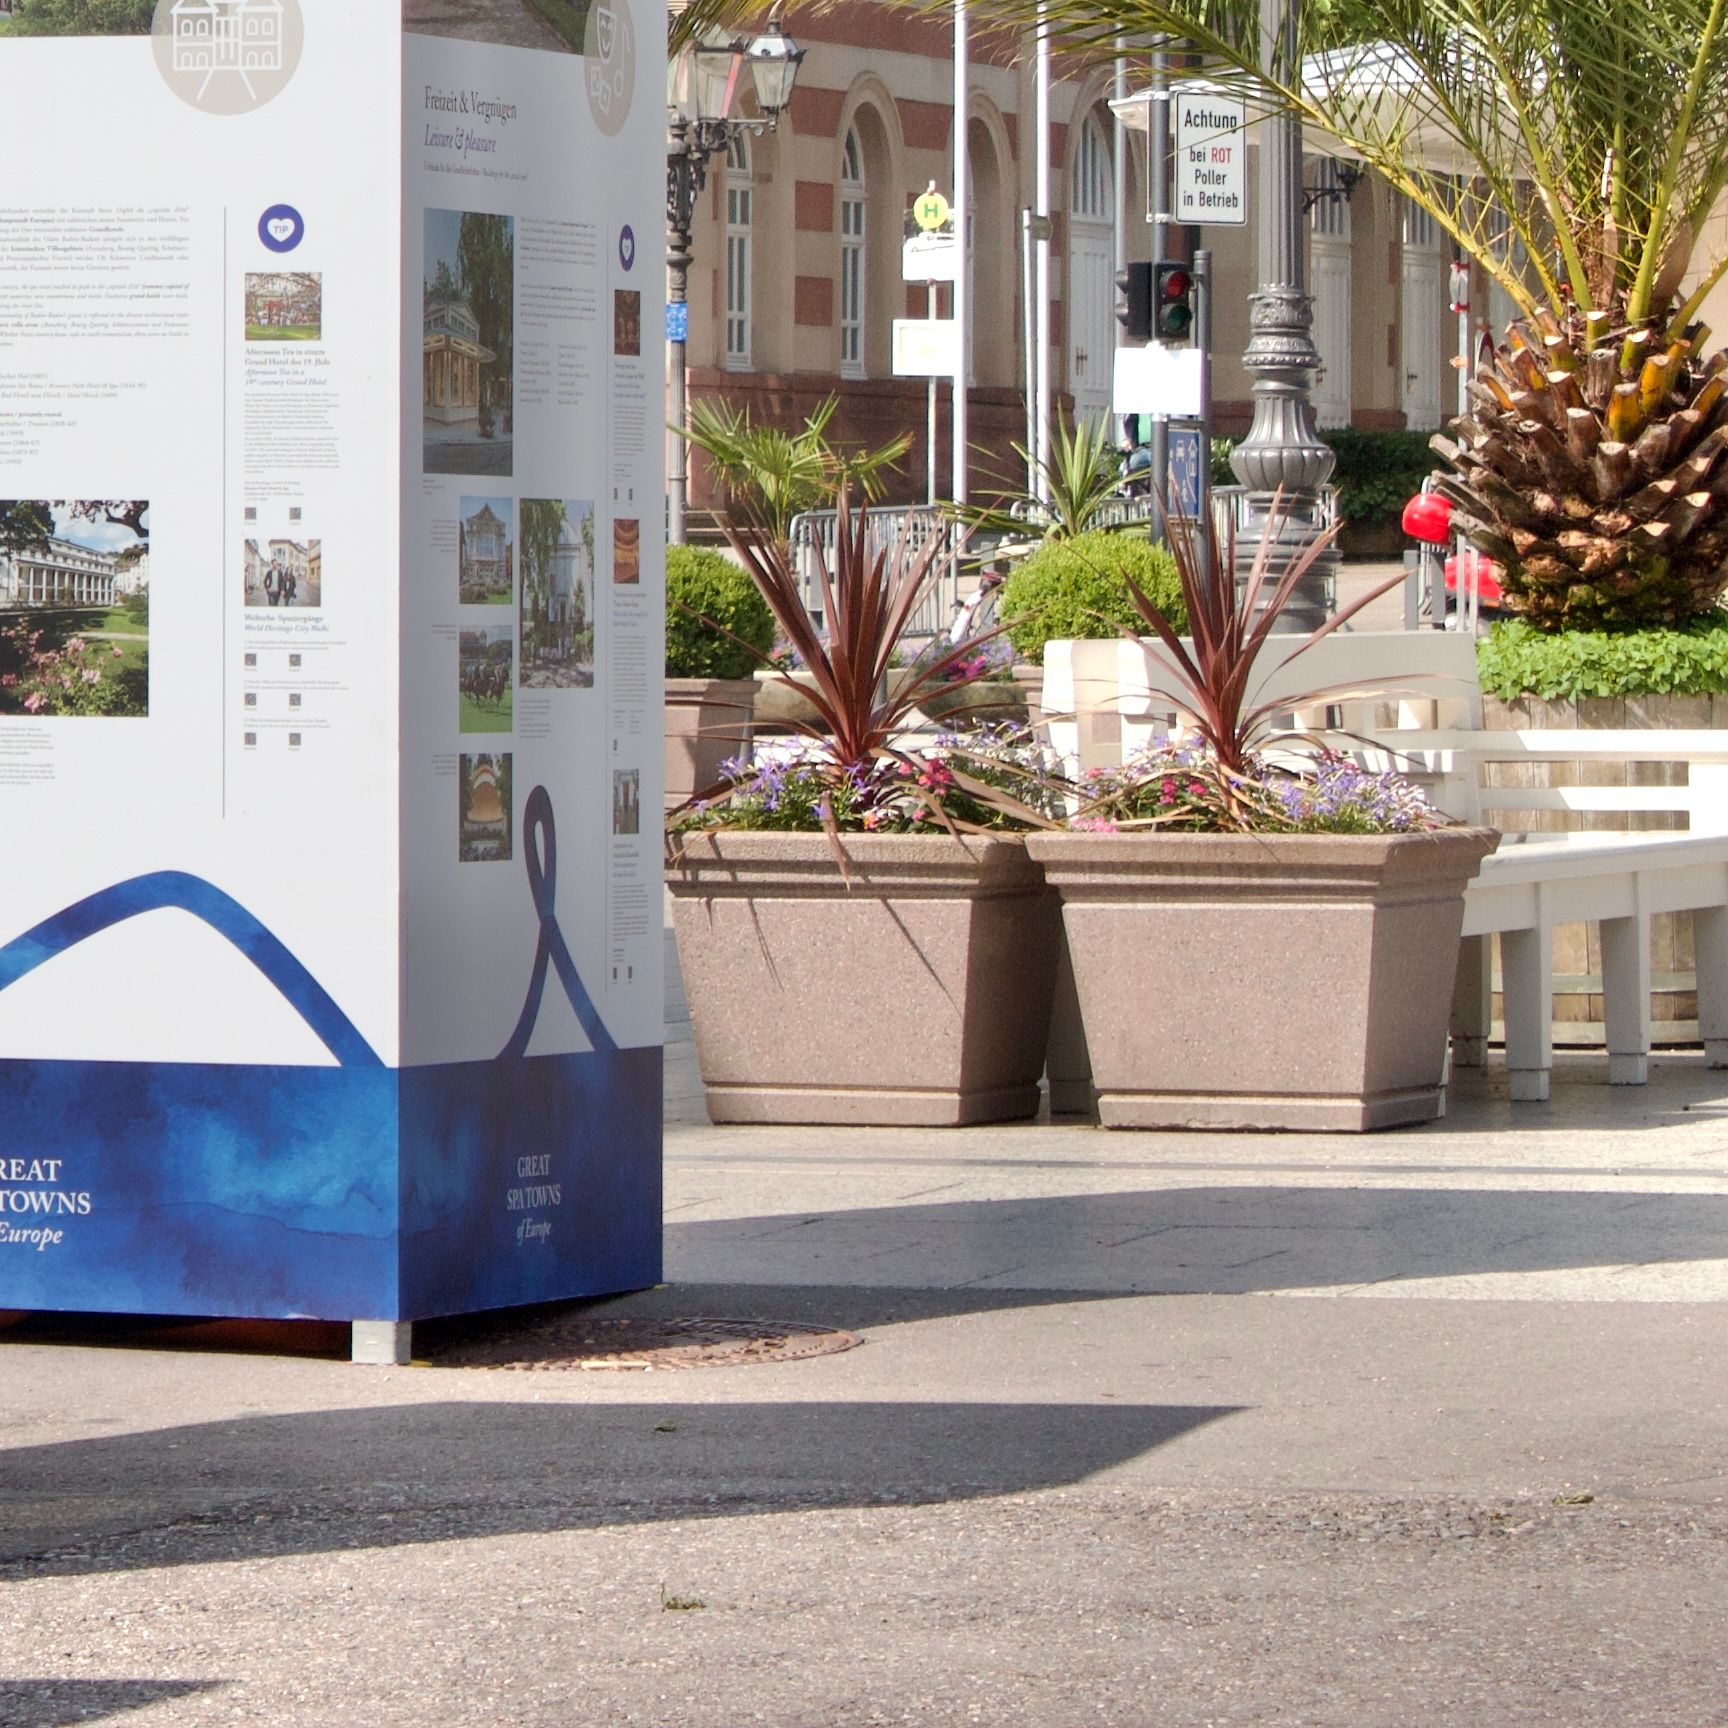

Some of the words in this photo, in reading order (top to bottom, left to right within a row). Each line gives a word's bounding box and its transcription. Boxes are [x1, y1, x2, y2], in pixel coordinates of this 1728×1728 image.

[424, 85, 457, 113] Freizeit
[459, 90, 469, 114] &
[470, 91, 517, 126] Vergnügen
[1184, 109, 1237, 130] Achtung
[424, 123, 454, 149] Leisure
[454, 126, 464, 150] &
[463, 129, 497, 160] pleasure
[1189, 146, 1207, 162] bei
[1211, 147, 1232, 164] ROT
[1195, 169, 1227, 185] Poller
[1183, 191, 1193, 206] in
[1199, 191, 1238, 208] Betrieb
[923, 203, 939, 218] H
[273, 225, 289, 234] TIP
[517, 1153, 551, 1178] GREAT
[507, 1188, 525, 1211] SPA
[526, 1183, 561, 1209] TOWNS
[516, 1218, 526, 1246] of
[525, 1217, 552, 1244] Europe
